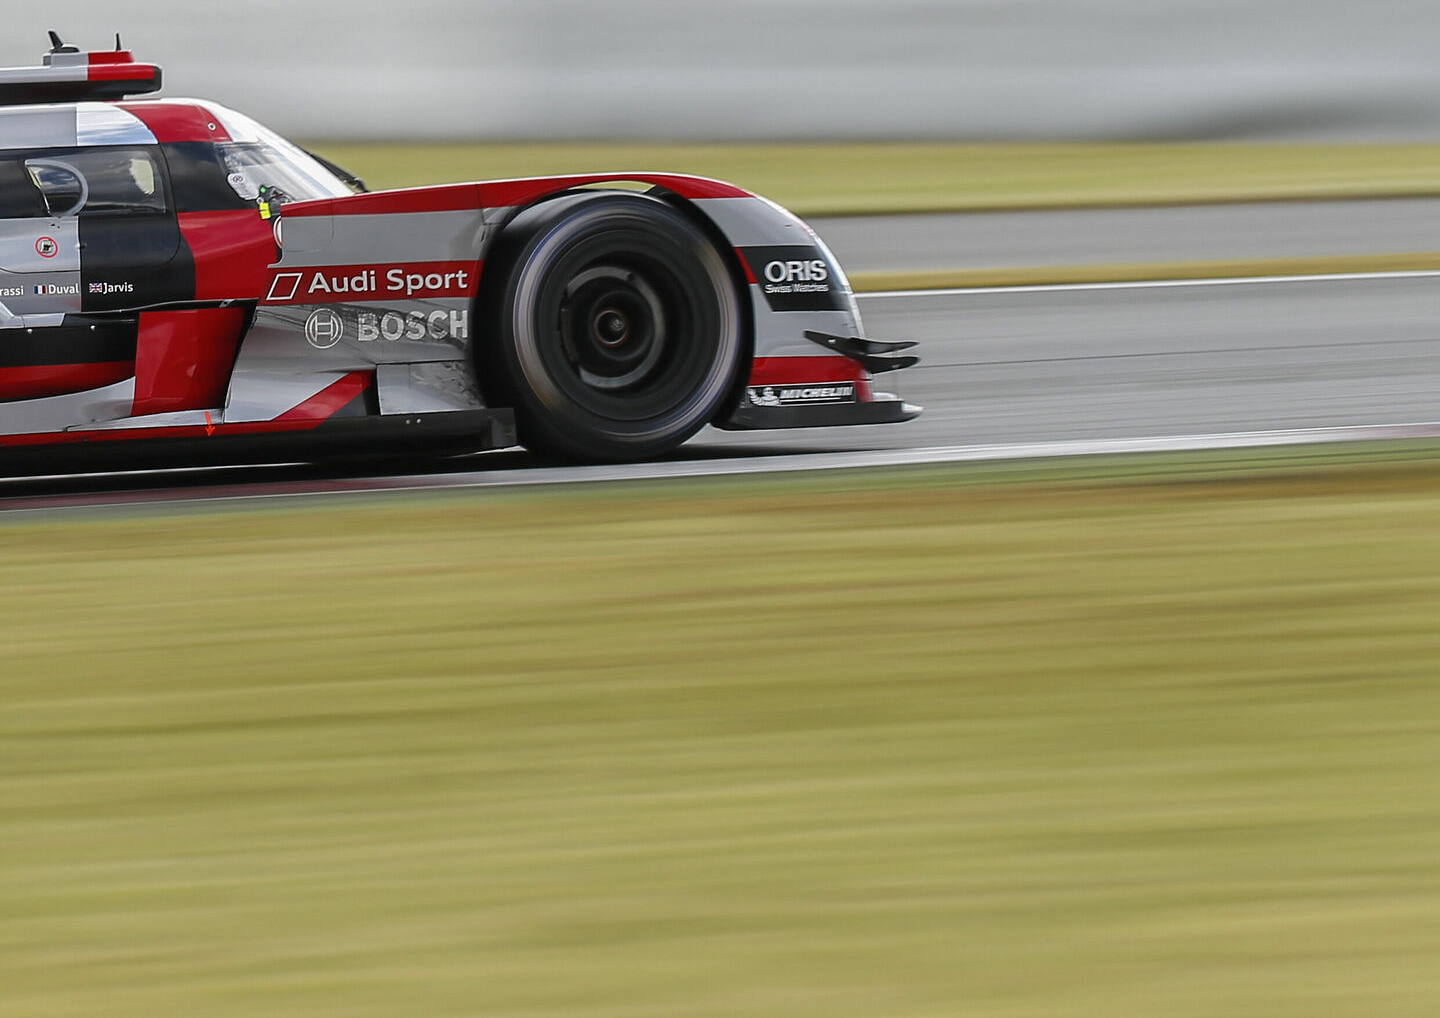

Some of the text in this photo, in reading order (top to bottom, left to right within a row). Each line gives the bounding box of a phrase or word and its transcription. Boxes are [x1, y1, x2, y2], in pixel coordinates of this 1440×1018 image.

[308, 269, 468, 295] Audi Sport
[764, 260, 827, 283] ORIS
[48, 284, 79, 294] Duval
[103, 282, 134, 294] Jarvis
[358, 310, 468, 342] BOSCH
[780, 387, 853, 399] MICHELIN
